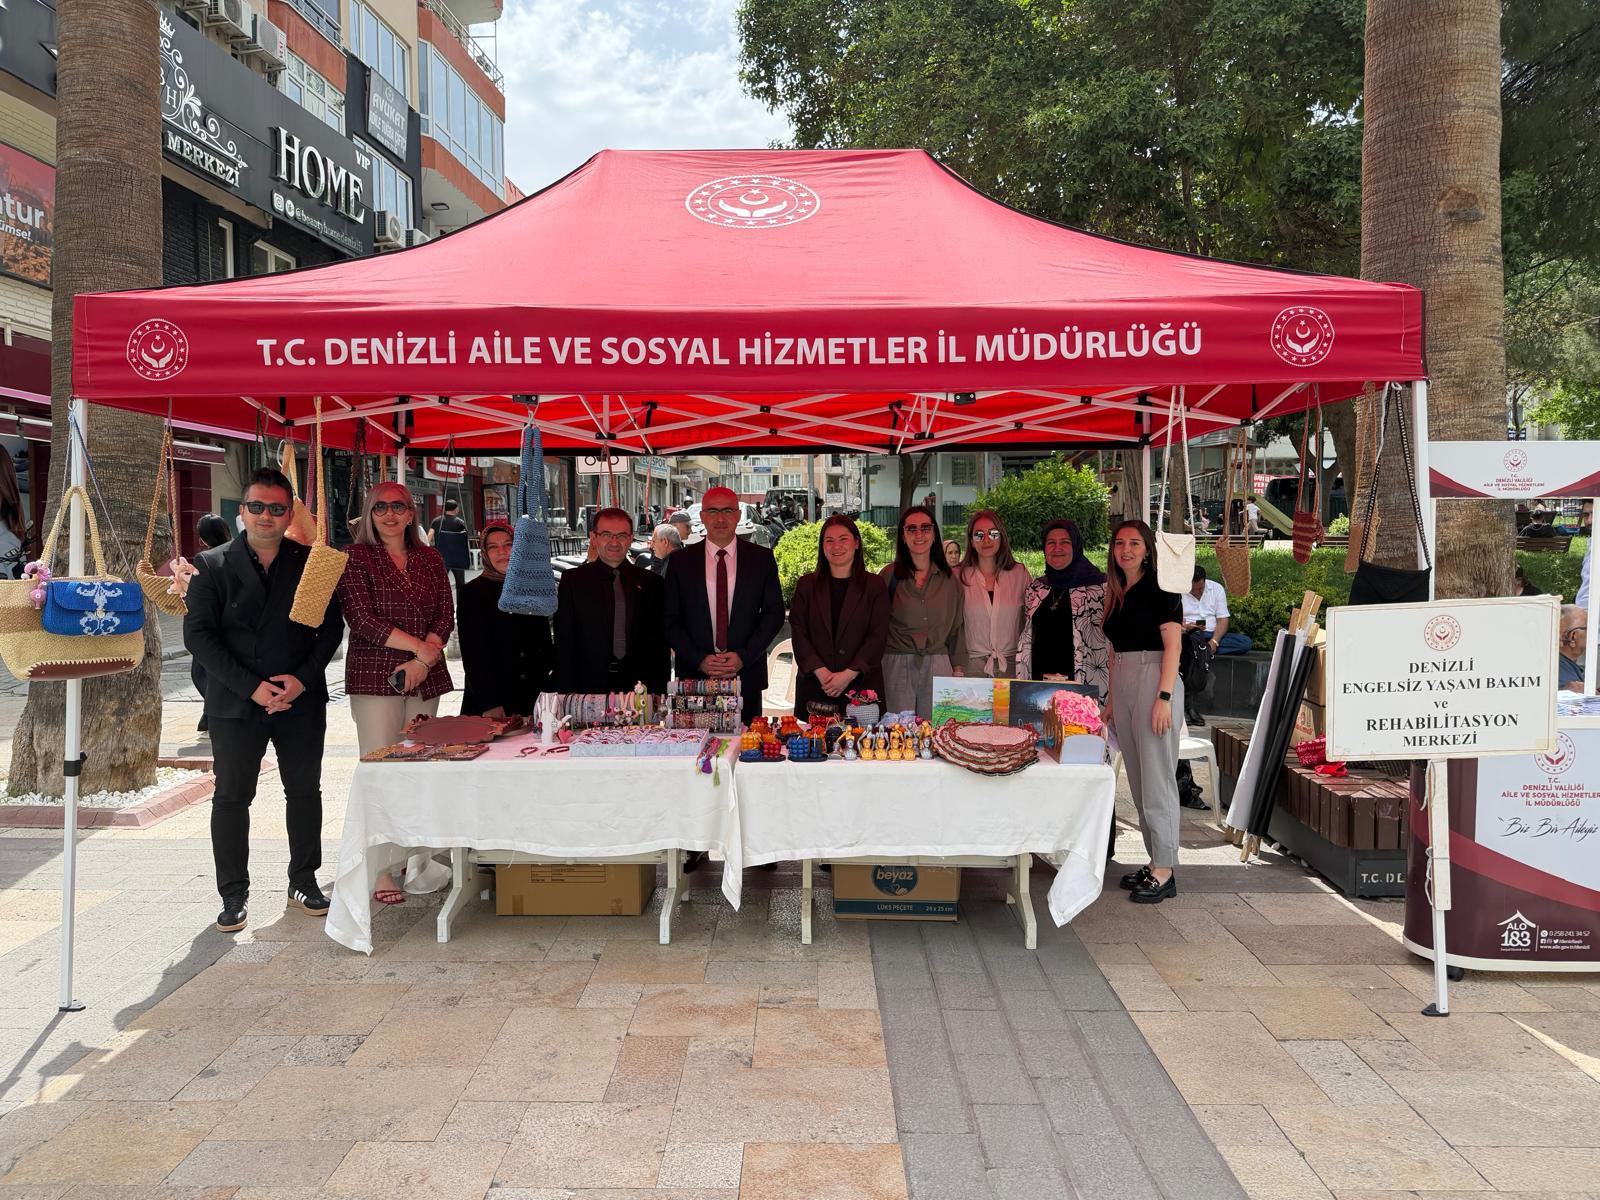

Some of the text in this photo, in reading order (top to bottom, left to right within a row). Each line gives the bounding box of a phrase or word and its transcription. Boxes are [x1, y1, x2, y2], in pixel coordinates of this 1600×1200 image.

[372, 93, 406, 130] AVUKAT
[167, 130, 240, 188] MERKEZİ
[355, 149, 371, 170] VIP
[278, 126, 365, 225] HOME
[0, 192, 44, 229] tur
[257, 321, 1202, 366] T.C. DENİZLİ AİLE VE SOSYAL HİZMETLER İL MÜDÜRLÜĞÜ
[1408, 657, 1474, 674] DENİZLİ
[1343, 675, 1541, 694] ENGELSİZ YAŞAM BAKIM
[1433, 700, 1449, 709] ve
[1366, 713, 1520, 732] REHABİLİTASYON
[1403, 730, 1478, 748] MERKEZİ
[1501, 790, 1518, 798] AİLE
[1522, 783, 1585, 791] DENİZLİ VALİLİĞİ
[1525, 798, 1581, 807] İL MÜDÜRLÜĞÜ
[876, 870, 914, 883] beyaz
[1360, 873, 1383, 884] T.C.
[1507, 922, 1527, 931] ALO
[1501, 930, 1531, 947] 183
